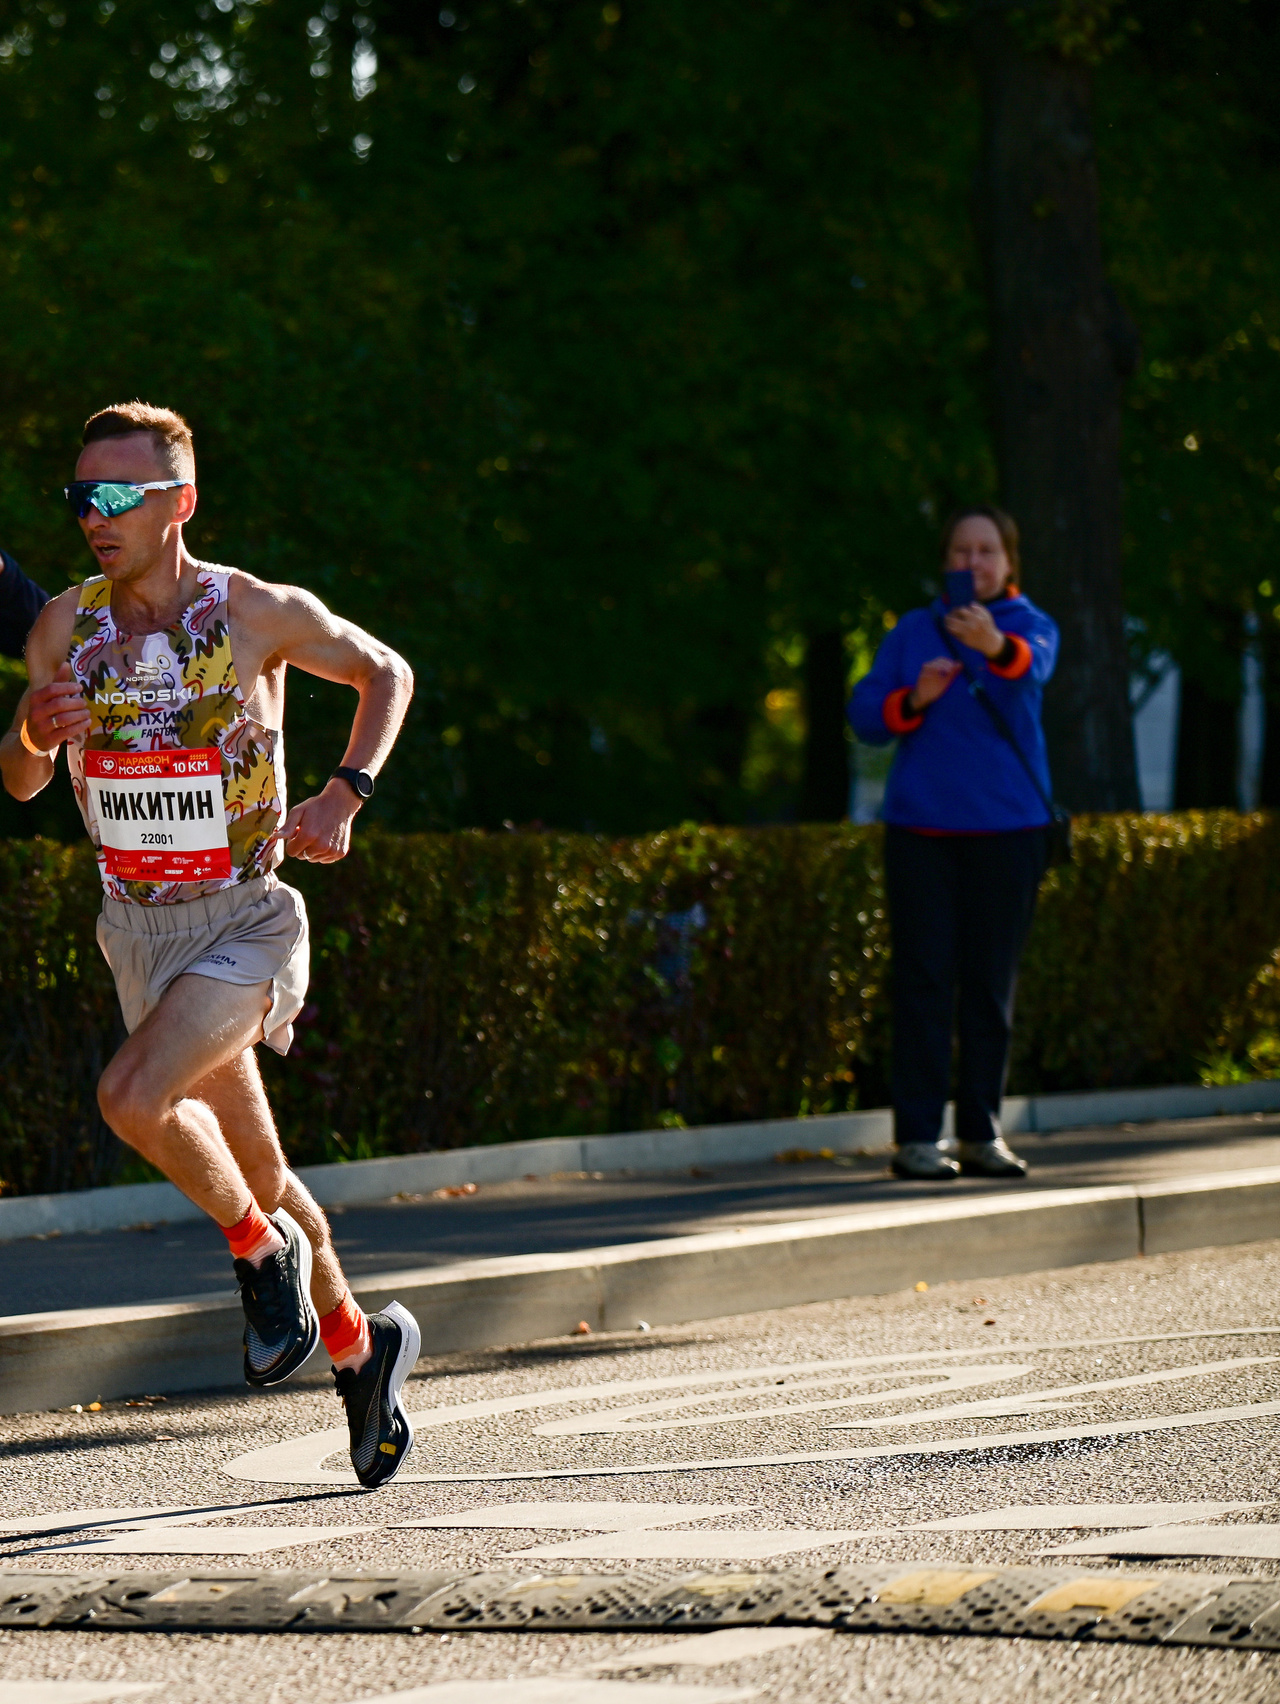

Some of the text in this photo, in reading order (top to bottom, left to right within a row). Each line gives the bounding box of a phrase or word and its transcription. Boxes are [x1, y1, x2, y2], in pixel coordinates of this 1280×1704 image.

[94, 687, 193, 705] NORDSKI
[97, 710, 194, 726] УРАЛХИМ
[118, 755, 170, 766] МАРАФОН
[118, 760, 209, 775] МОСКВА 10 КМ
[99, 789, 215, 821] НИКИТИН
[140, 833, 174, 845] 22001
